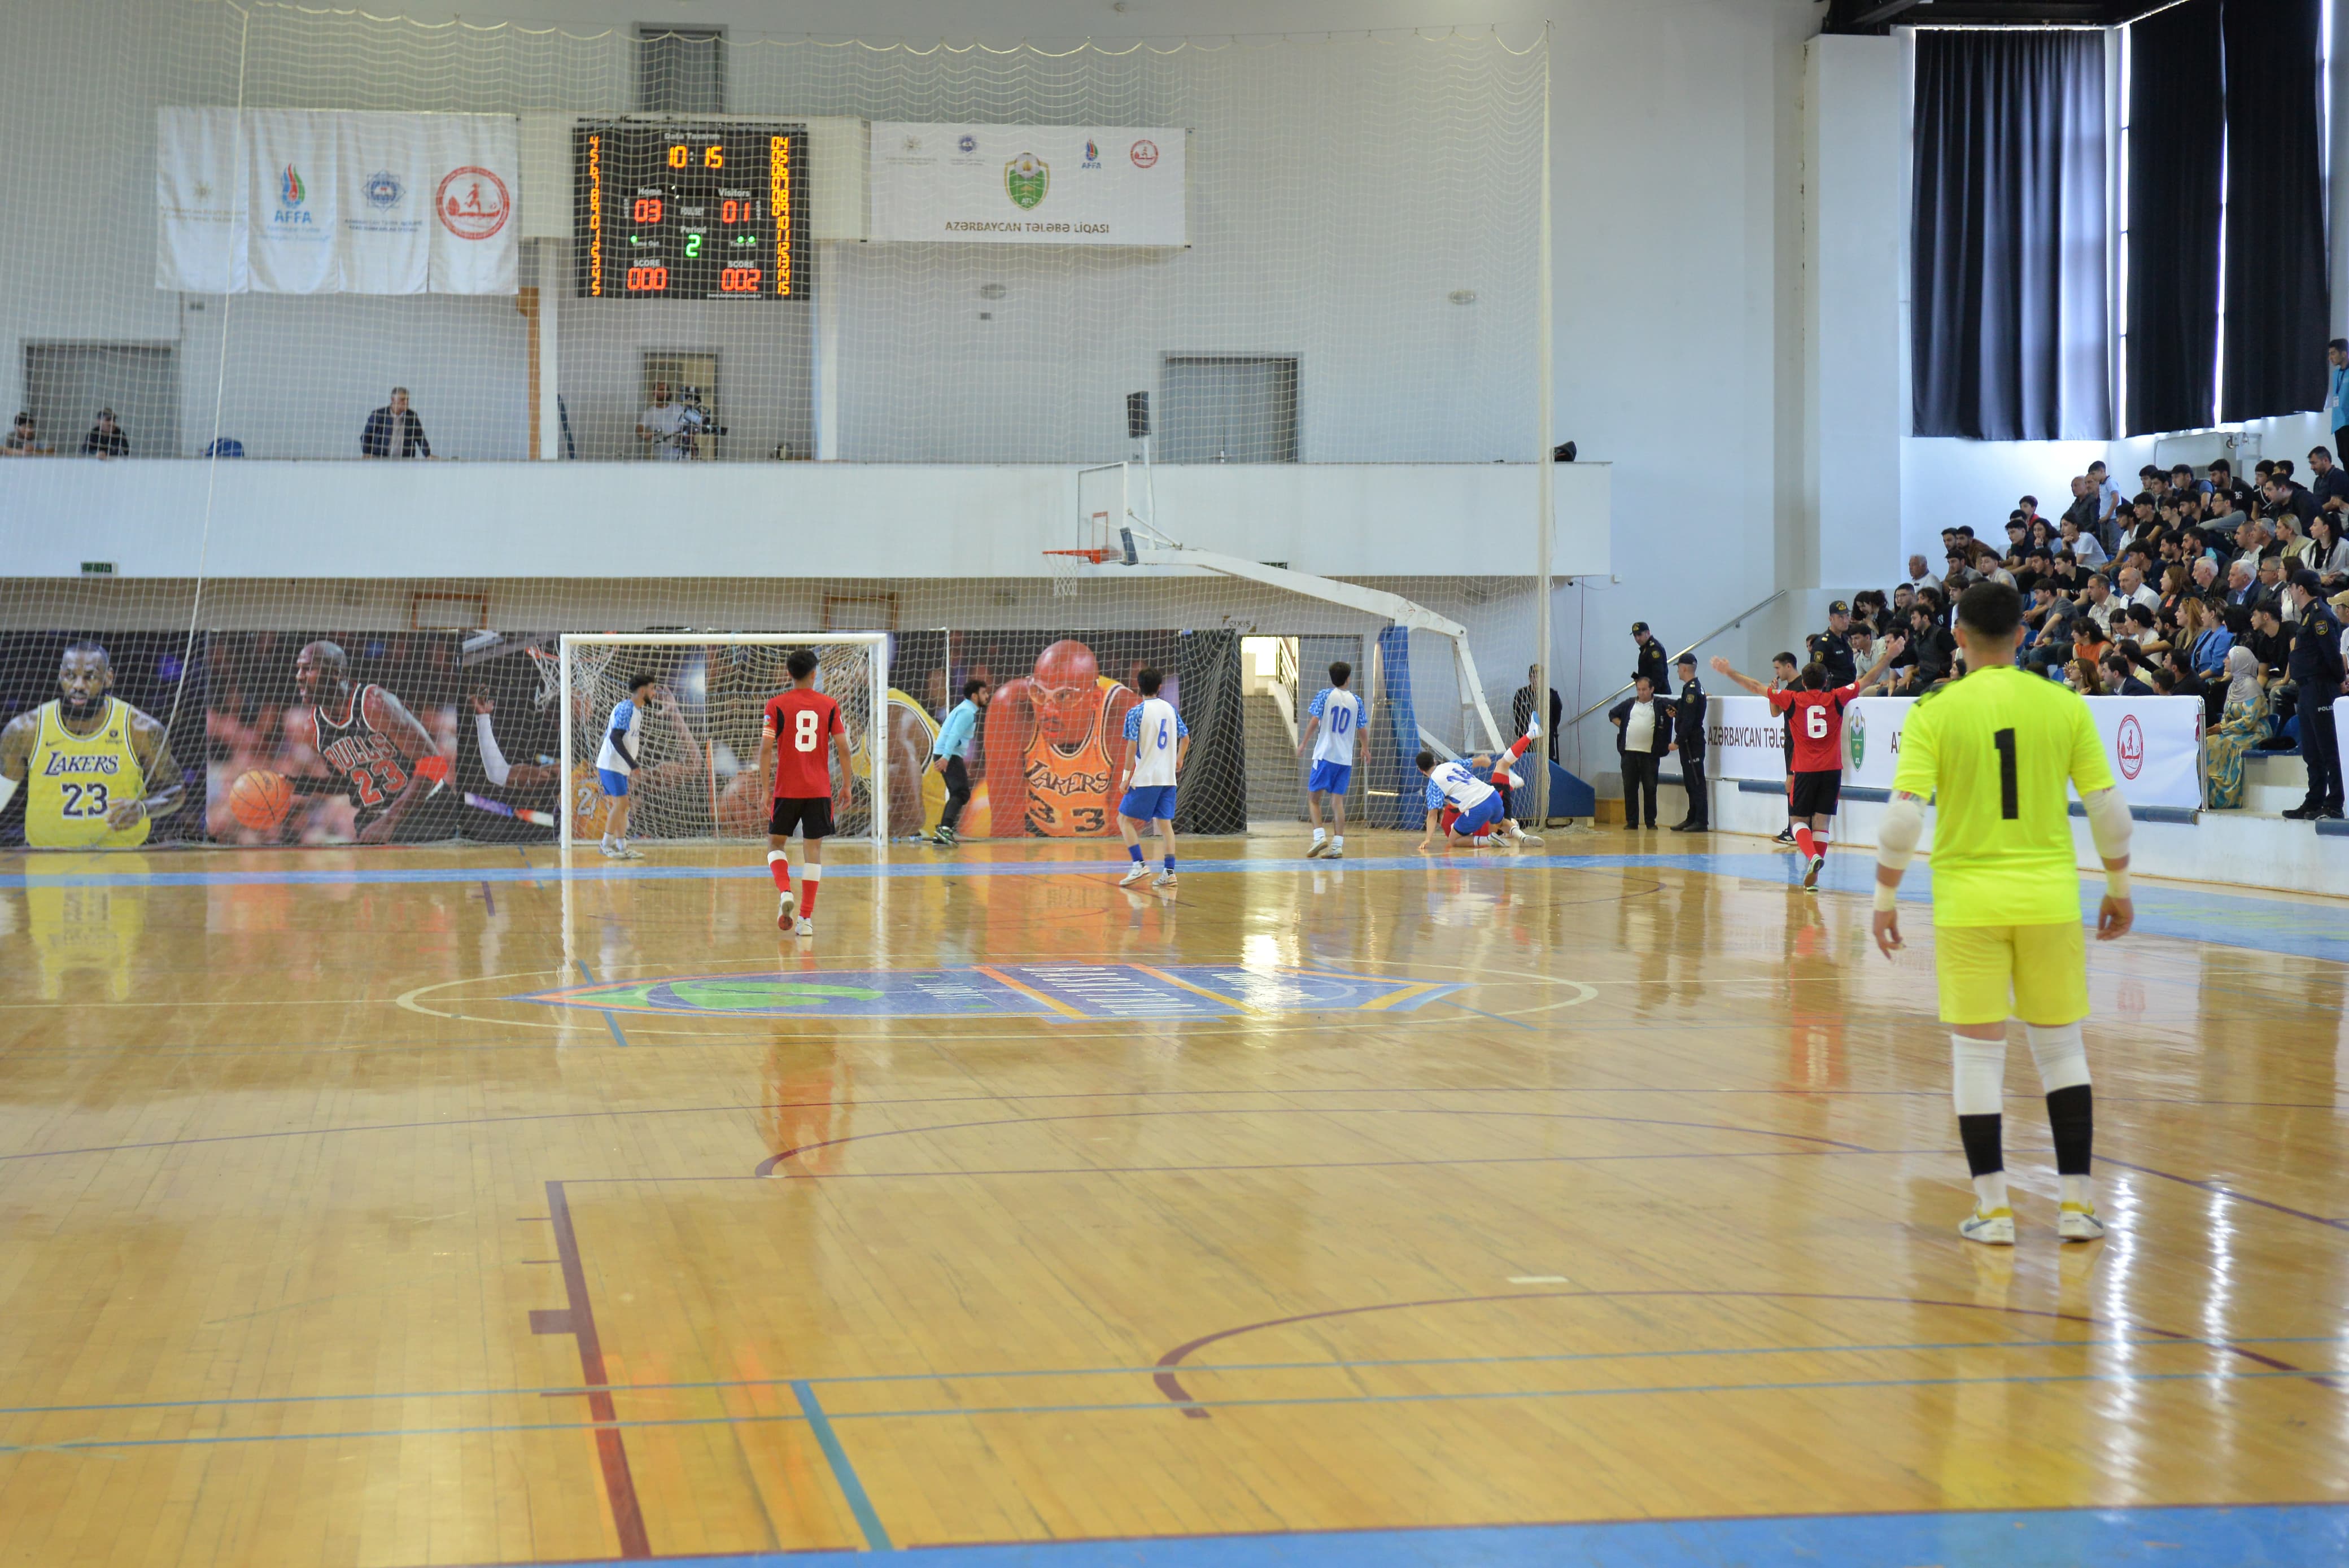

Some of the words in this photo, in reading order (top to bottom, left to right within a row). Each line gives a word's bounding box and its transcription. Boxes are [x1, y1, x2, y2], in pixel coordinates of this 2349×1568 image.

[771, 136, 789, 150] 04
[771, 150, 788, 163] 05
[771, 163, 788, 176] 06
[718, 187, 750, 197] Visitors
[771, 176, 789, 189] 07
[771, 189, 789, 203] 08
[274, 210, 312, 223] AFFA
[635, 199, 662, 222] 03
[723, 200, 750, 223] 01
[772, 203, 789, 216] 09
[777, 216, 789, 229] 10
[945, 221, 1021, 232] AZƏRBAYCAN
[1025, 222, 1070, 233] TƏLƏBƏ
[686, 234, 700, 257] 2
[777, 229, 789, 242] 11
[777, 242, 789, 255] 12
[777, 255, 789, 269] 13
[627, 267, 667, 290] 000
[722, 268, 761, 291] 002
[778, 268, 789, 281] 14
[778, 281, 789, 295] 15
[1331, 705, 1351, 734] 10
[1807, 705, 1827, 738] 6
[795, 710, 818, 752] 8
[1158, 719, 1167, 750] 6
[1708, 726, 1761, 747] AZƏRBAYCAN
[43, 751, 120, 777] LAKERS
[1994, 727, 2019, 820] 1
[351, 759, 408, 806] 23
[1024, 759, 1111, 796] LAKERS
[61, 783, 110, 818] 23
[1020, 967, 1206, 1015] BASKETBOL
